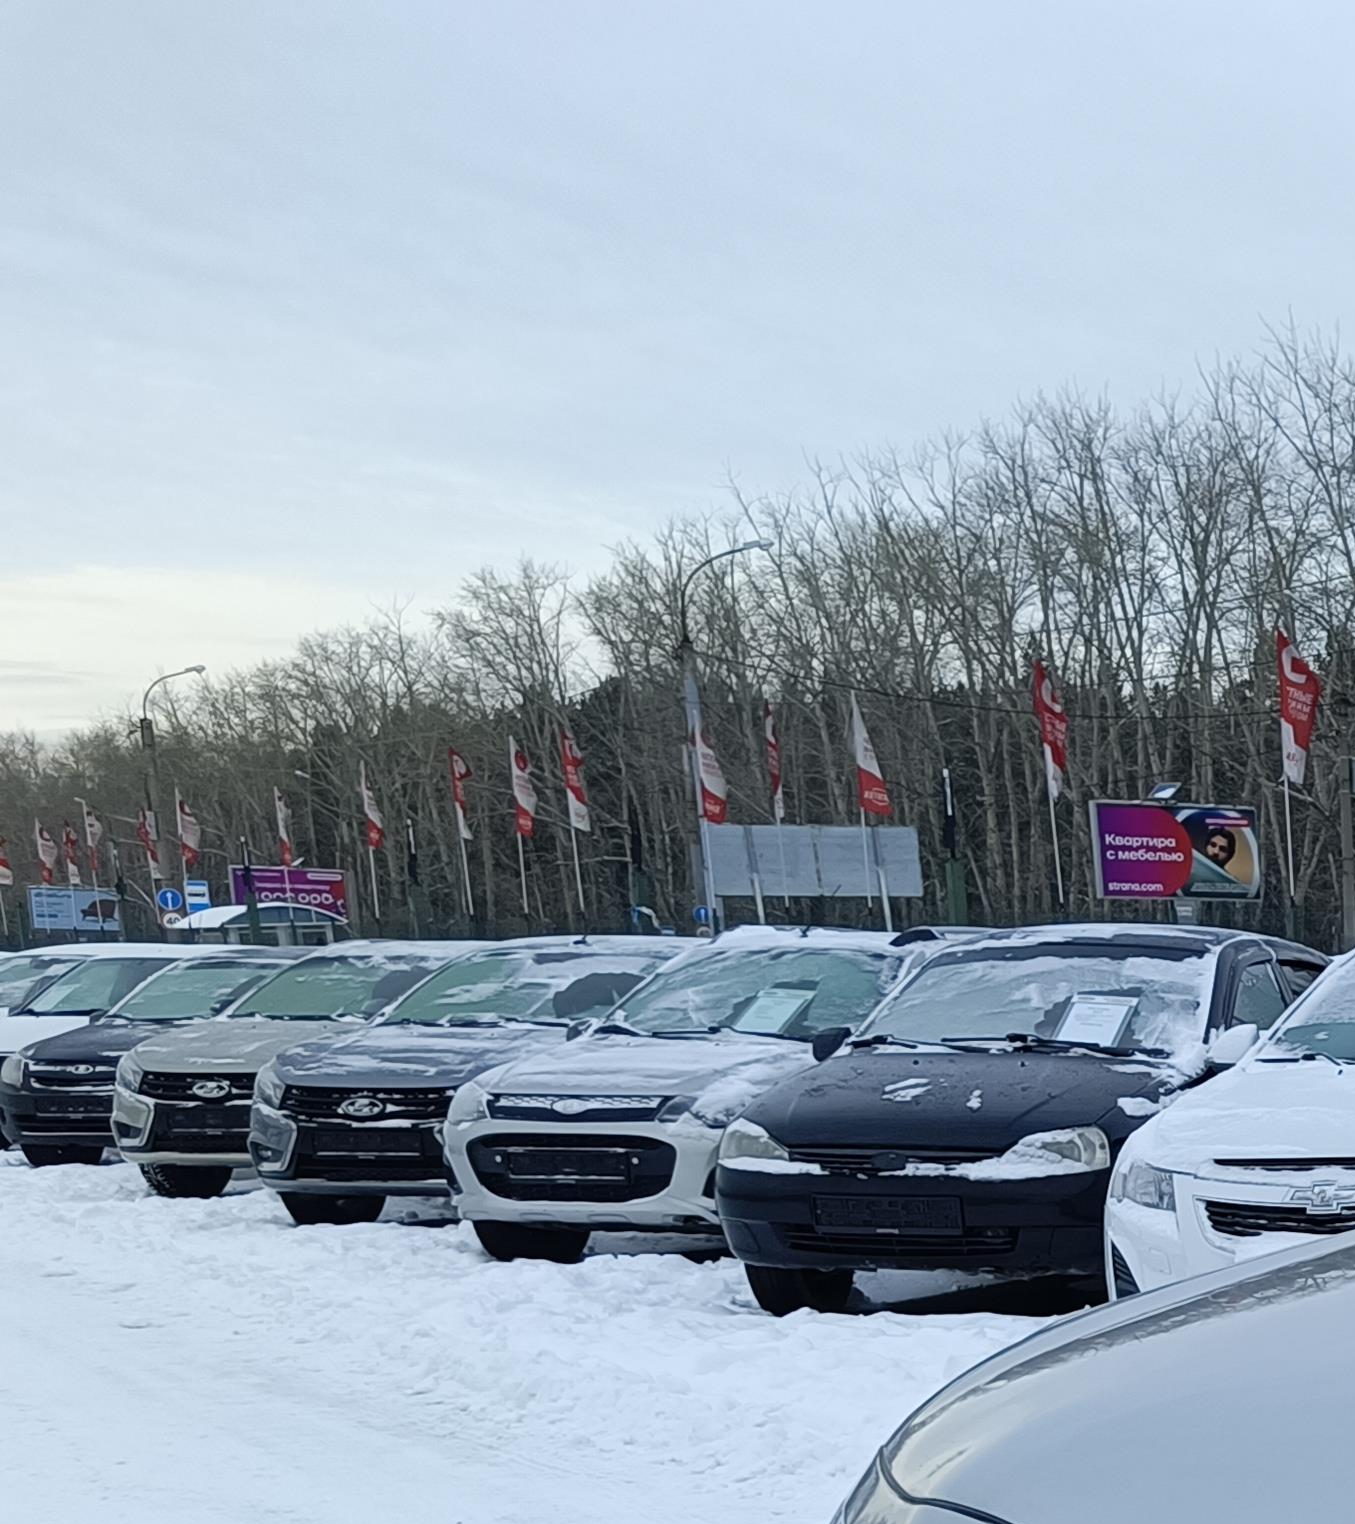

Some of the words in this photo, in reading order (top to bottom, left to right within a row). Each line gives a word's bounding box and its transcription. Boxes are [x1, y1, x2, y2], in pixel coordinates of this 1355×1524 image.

[1105, 834, 1176, 847] Квартира
[1106, 851, 1117, 860] с
[1118, 849, 1184, 862] мебелью
[1108, 882, 1163, 892] strana.com
